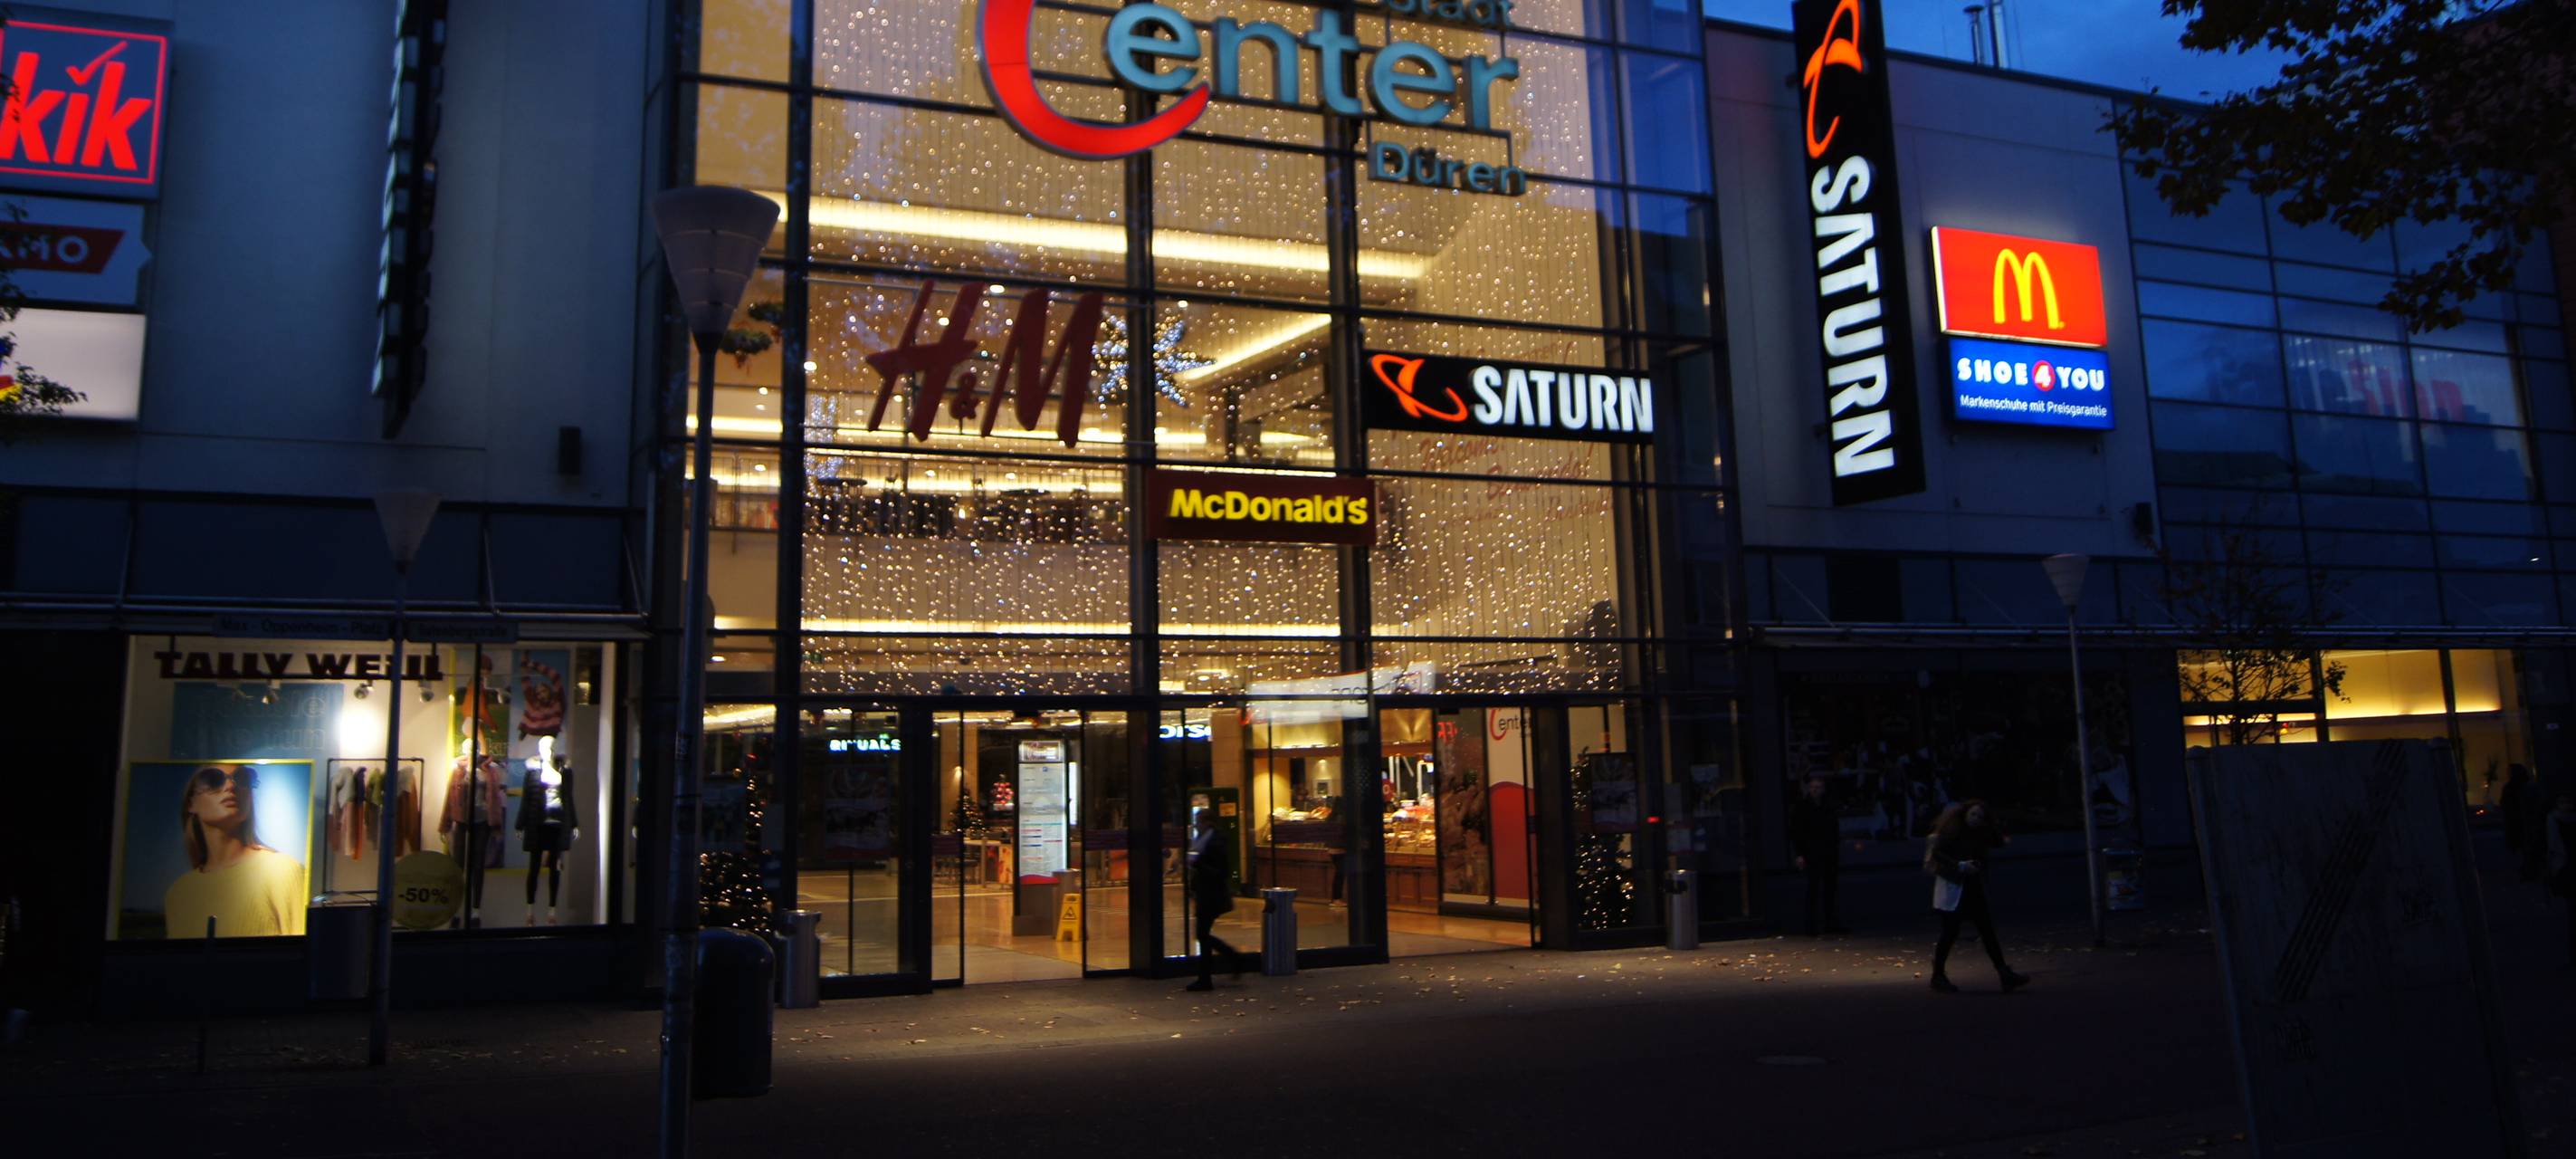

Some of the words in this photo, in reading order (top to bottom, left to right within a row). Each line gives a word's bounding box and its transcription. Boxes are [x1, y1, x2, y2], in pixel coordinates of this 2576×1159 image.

[0, 43, 153, 172] kik
[1369, 141, 1527, 196] Düren
[1811, 153, 1899, 479] SATURN
[865, 280, 1104, 448] H&M
[1957, 357, 2028, 387] SHOE
[2033, 363, 2053, 389] 4
[2056, 366, 2106, 392] YOU
[1471, 364, 1655, 434] SATURN
[1960, 394, 2027, 412] Markenschuhe
[2029, 400, 2046, 414] mit
[2046, 400, 2108, 418] Preisgarantie
[1168, 487, 1369, 527] McDonald's
[155, 651, 291, 677] TALLY
[397, 886, 450, 905] -50%
